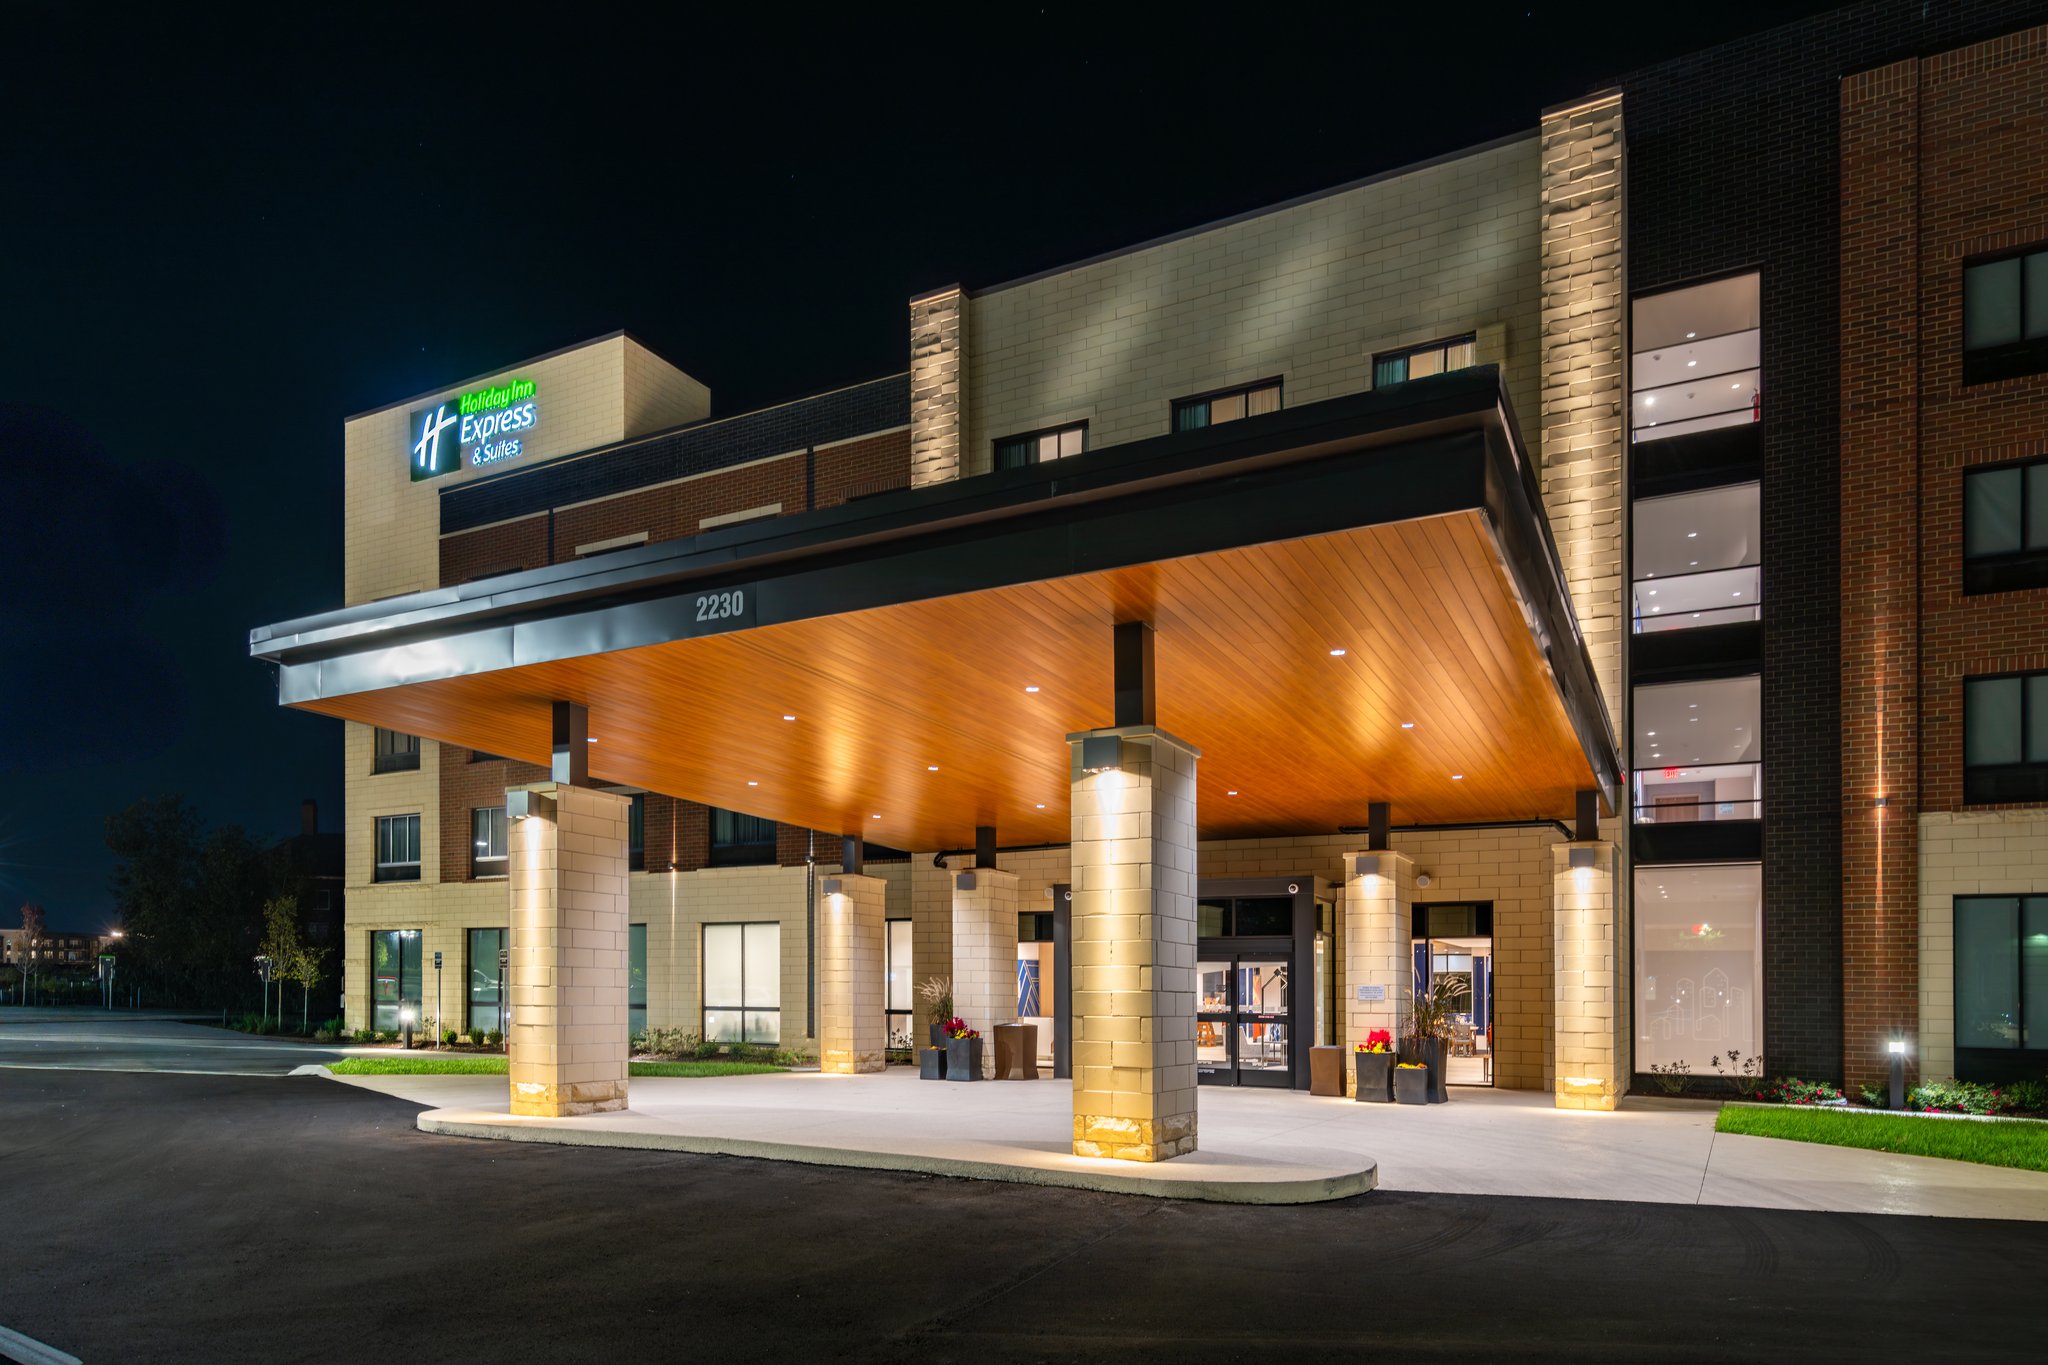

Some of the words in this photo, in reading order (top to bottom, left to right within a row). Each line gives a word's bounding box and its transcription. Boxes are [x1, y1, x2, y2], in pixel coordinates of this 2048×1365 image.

[461, 386, 510, 414] Holiday
[511, 380, 533, 400] Inn
[461, 403, 533, 444] Express
[472, 447, 482, 464] &
[483, 440, 519, 462] Suites
[696, 590, 743, 622] 2230
